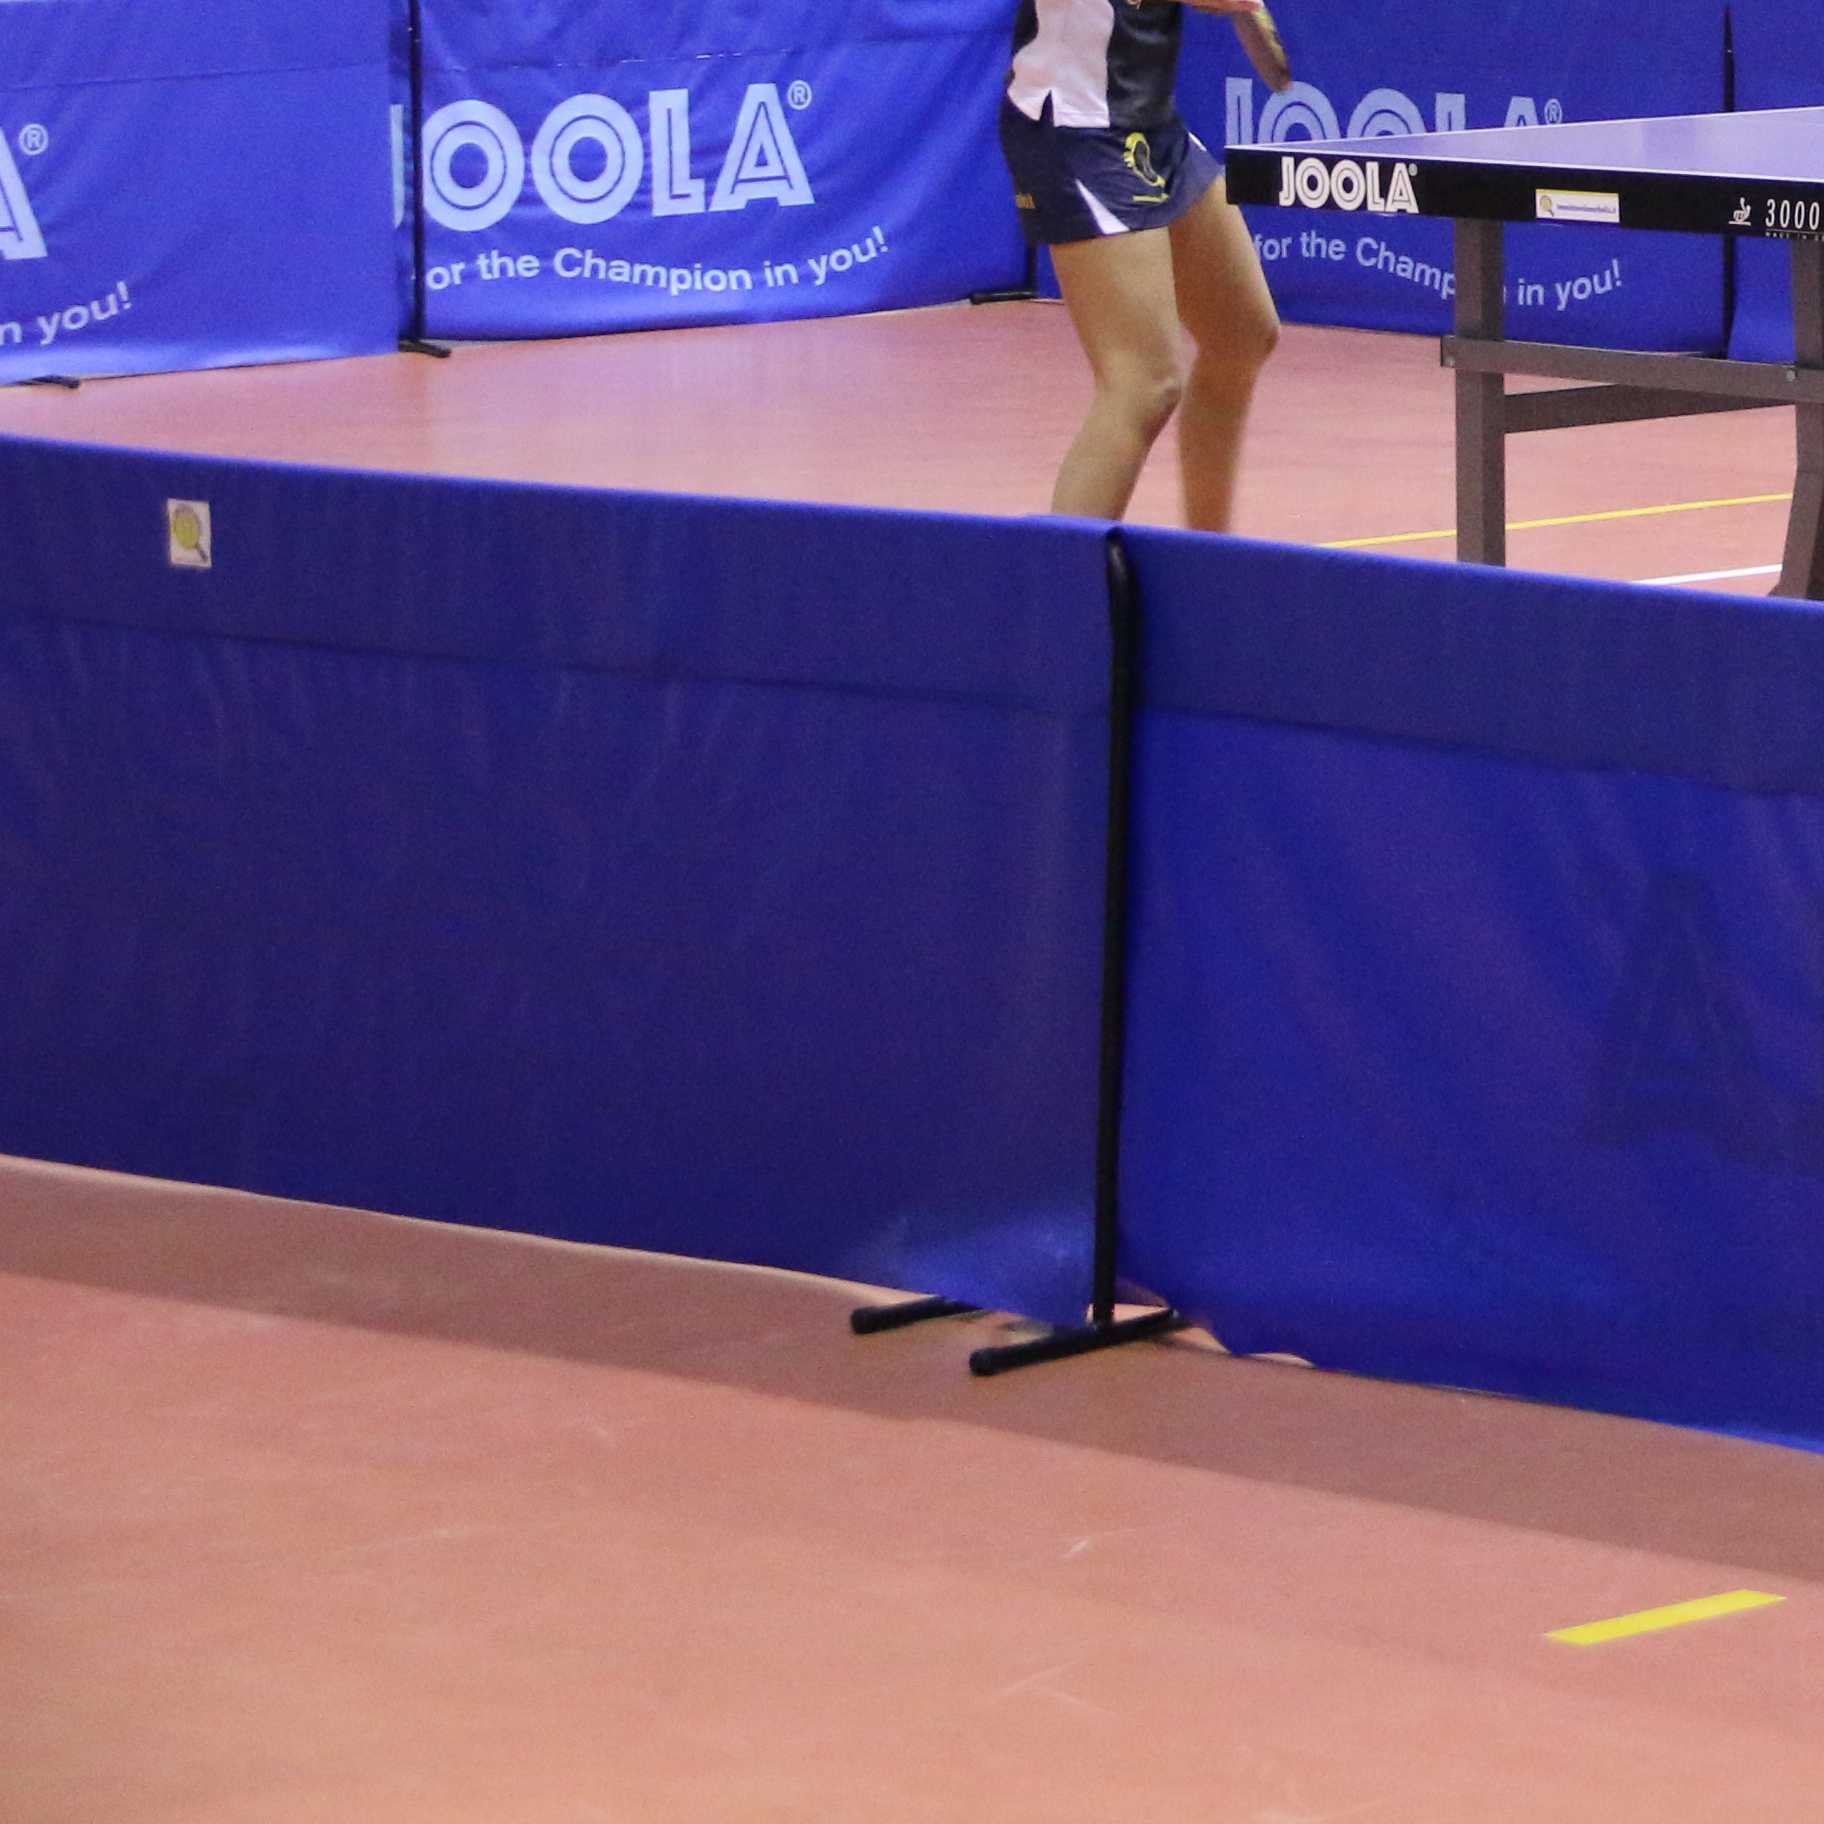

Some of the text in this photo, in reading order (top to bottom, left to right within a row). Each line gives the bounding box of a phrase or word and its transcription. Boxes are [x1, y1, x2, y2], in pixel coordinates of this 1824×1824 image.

[1765, 198, 1821, 231] 3000
[478, 225, 890, 296] the Champion in you!
[1299, 230, 1346, 261] the
[1517, 278, 1545, 306] in
[1555, 258, 1622, 311] you!
[37, 281, 135, 348] you!
